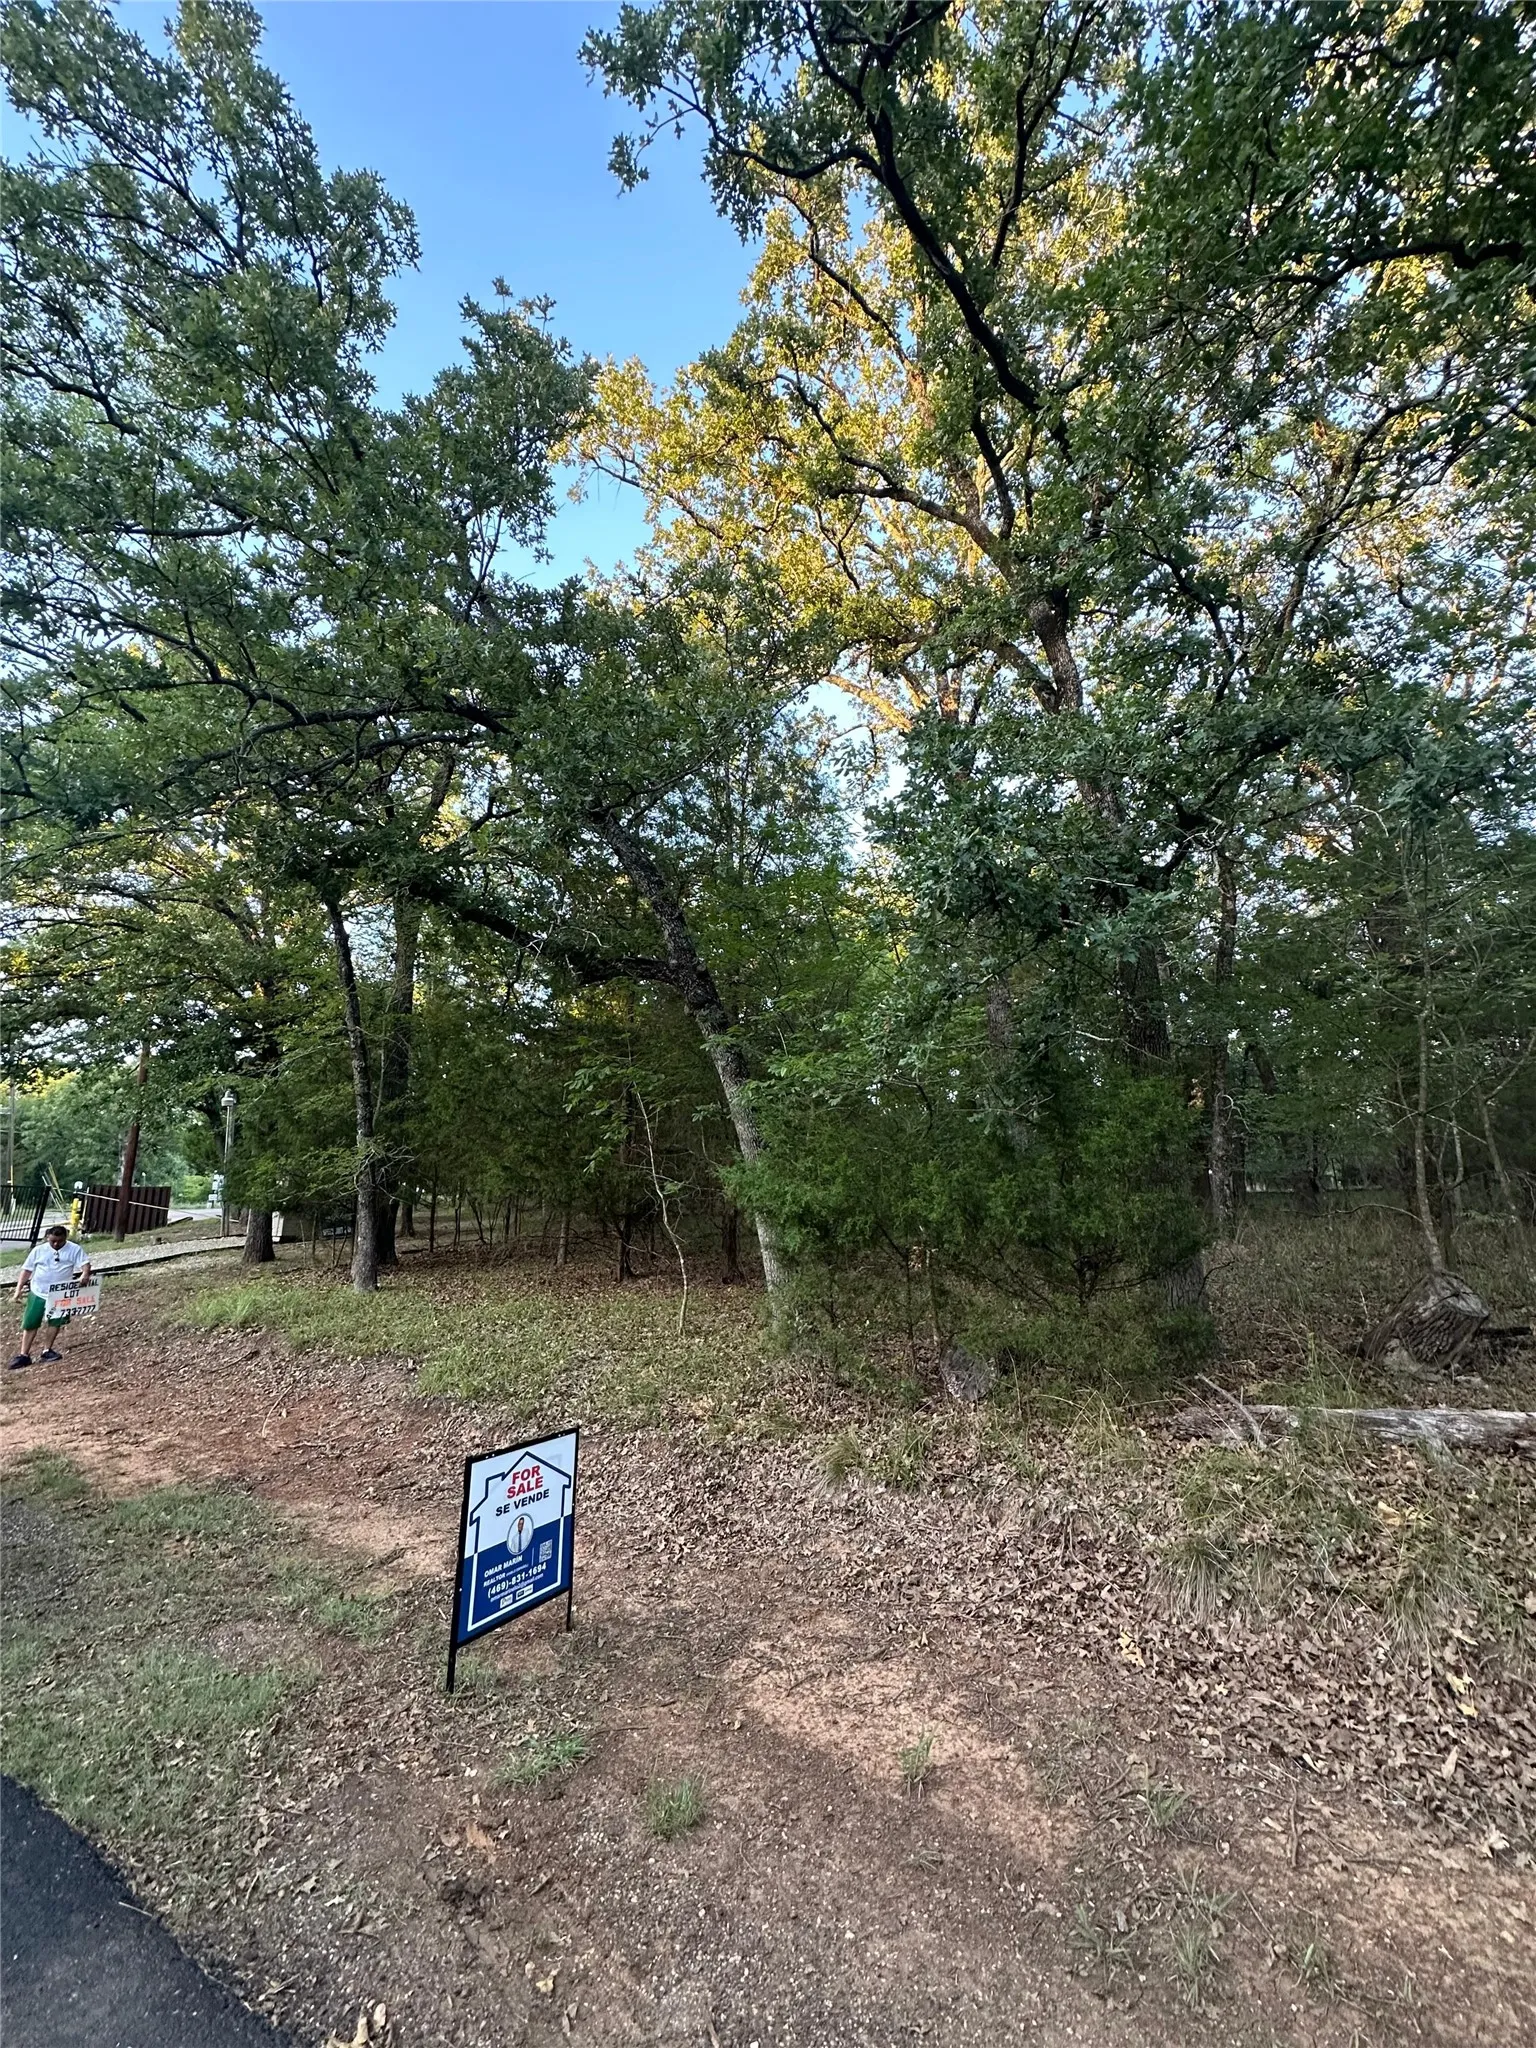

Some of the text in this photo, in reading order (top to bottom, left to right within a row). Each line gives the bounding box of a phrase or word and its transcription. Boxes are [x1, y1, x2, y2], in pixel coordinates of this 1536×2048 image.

[49, 1279, 99, 1292] RESIDEIAL
[64, 1289, 80, 1298] LOT
[76, 1295, 96, 1305] SALE
[512, 1465, 541, 1485] FOR
[507, 1476, 544, 1499] SALE
[495, 1489, 550, 1517] SE VENDE
[484, 1564, 503, 1578] OMAR
[483, 1572, 506, 1587] REALTOR
